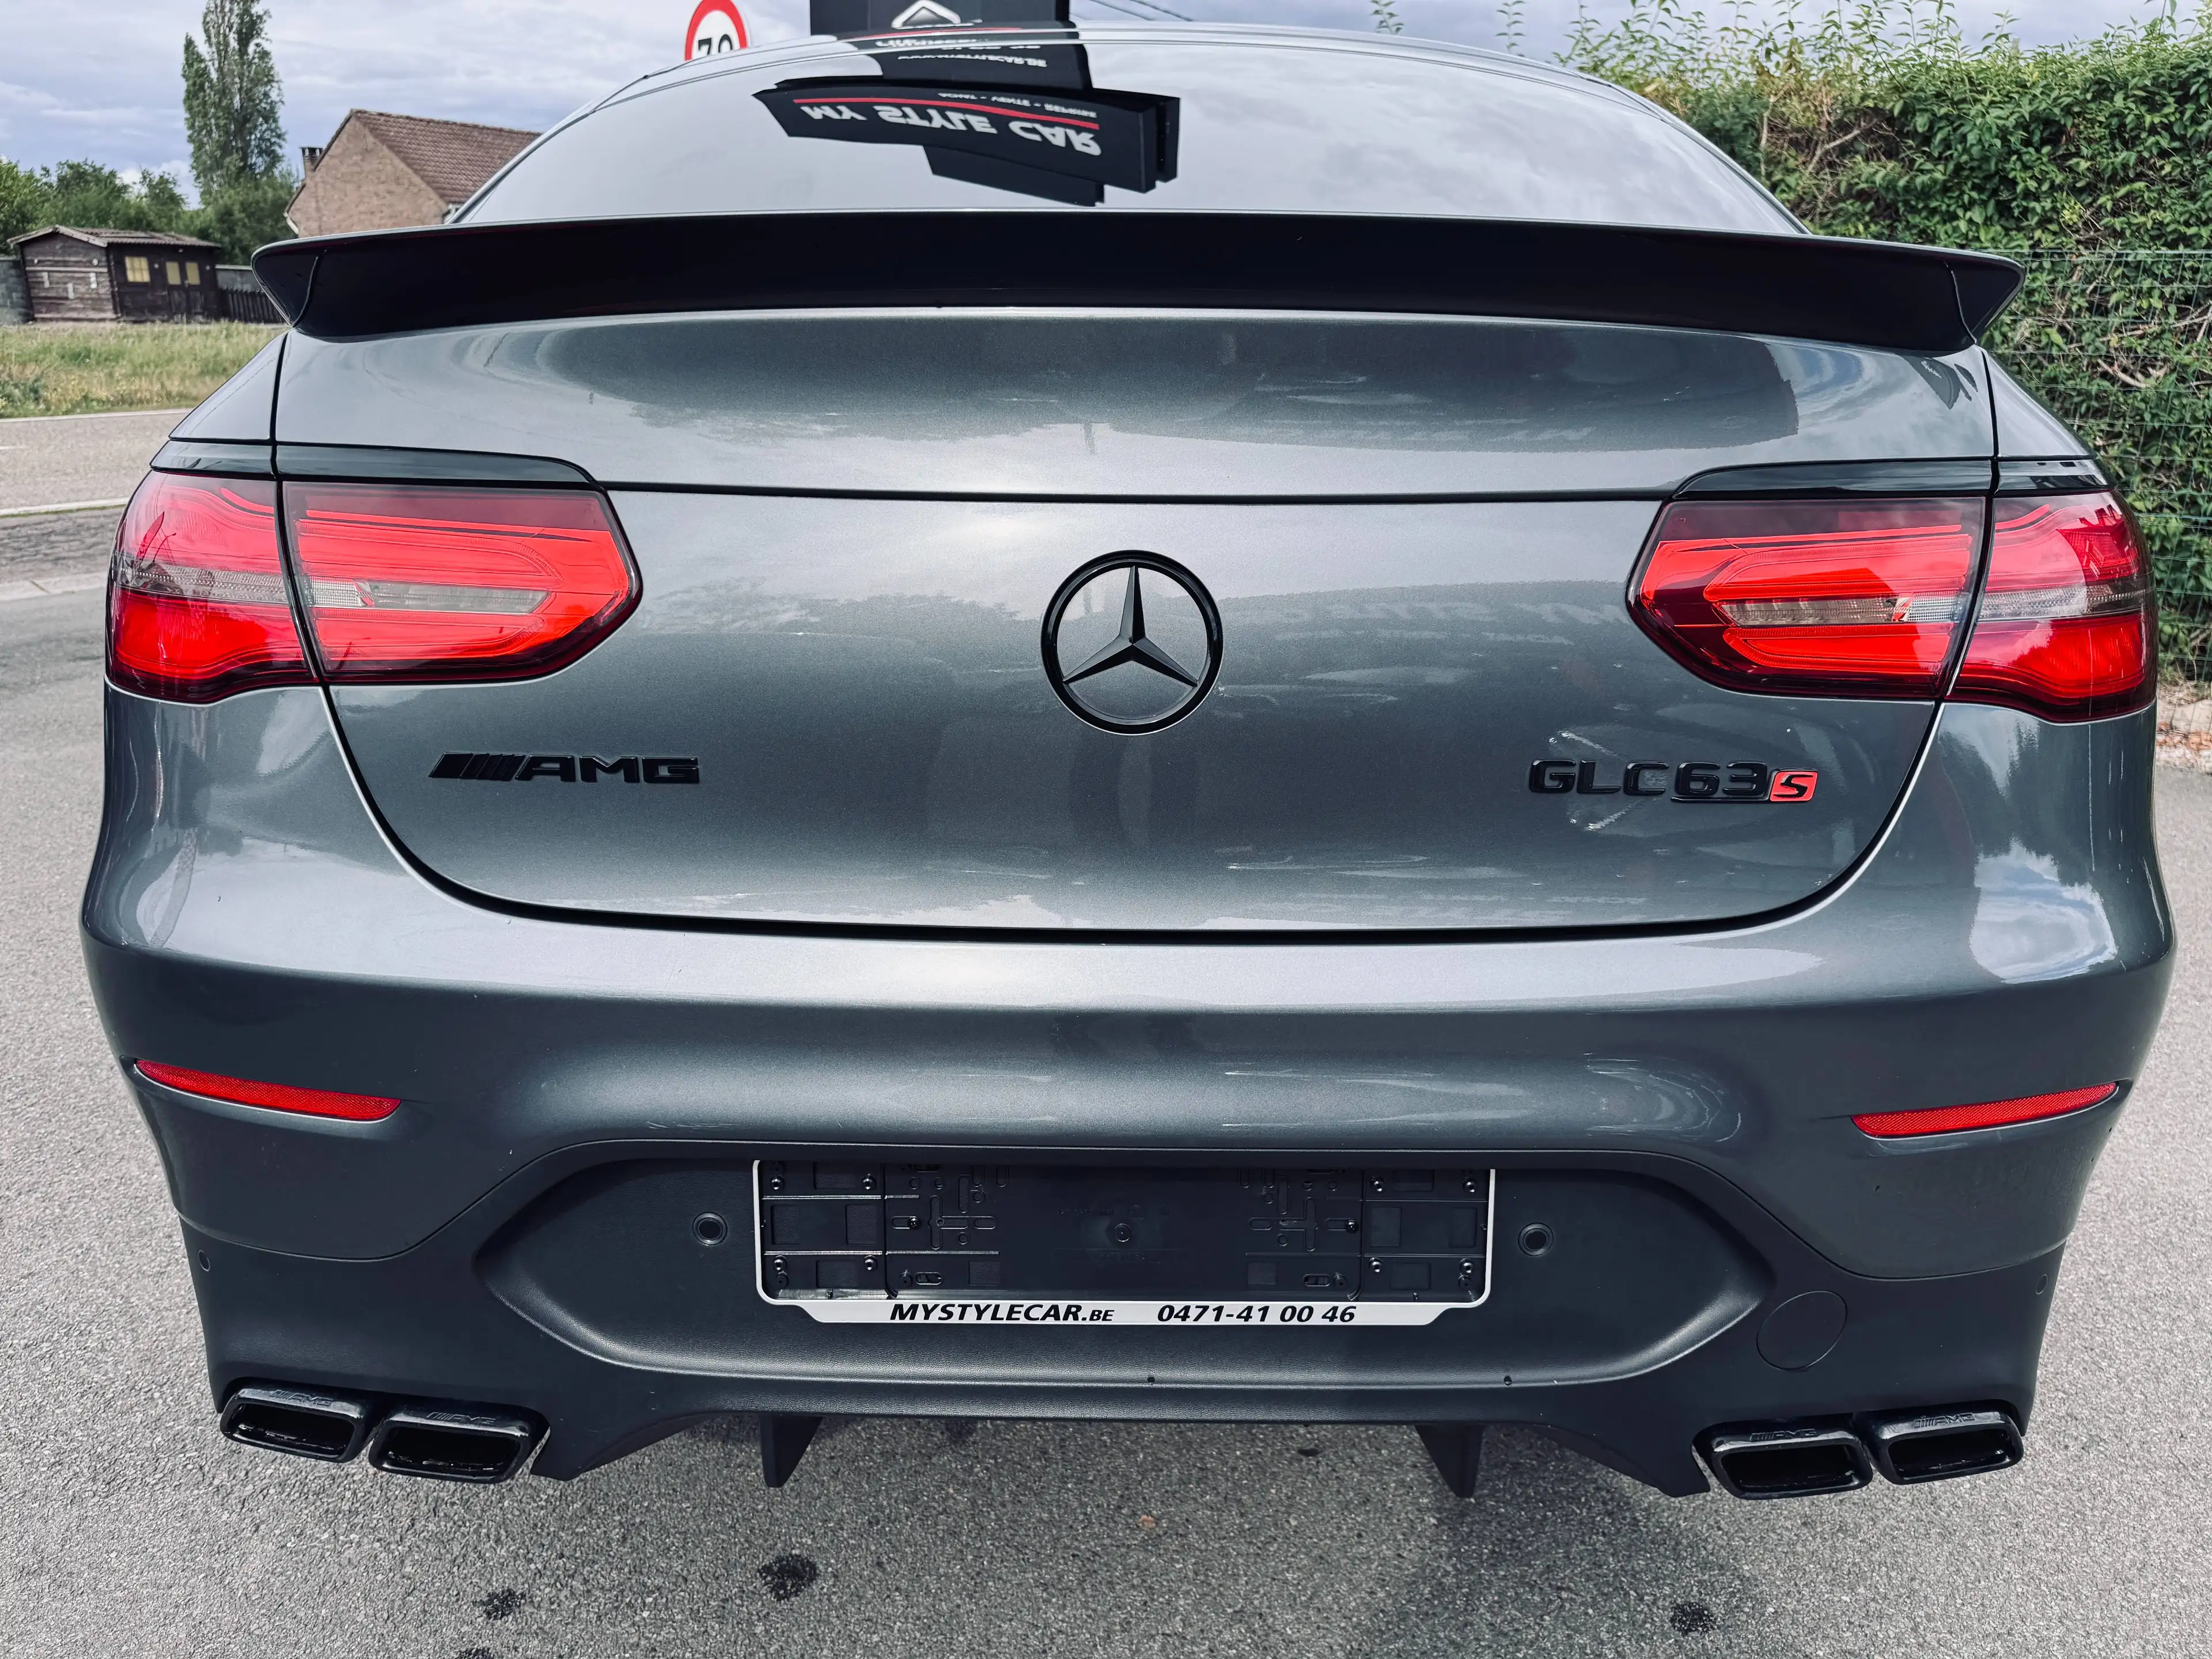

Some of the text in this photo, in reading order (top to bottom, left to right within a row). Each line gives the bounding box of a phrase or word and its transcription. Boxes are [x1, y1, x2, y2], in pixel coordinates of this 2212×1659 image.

[515, 754, 699, 783] AMG
[890, 1304, 1357, 1323] MYSTYLECAR.BE 0471-41 00 46
